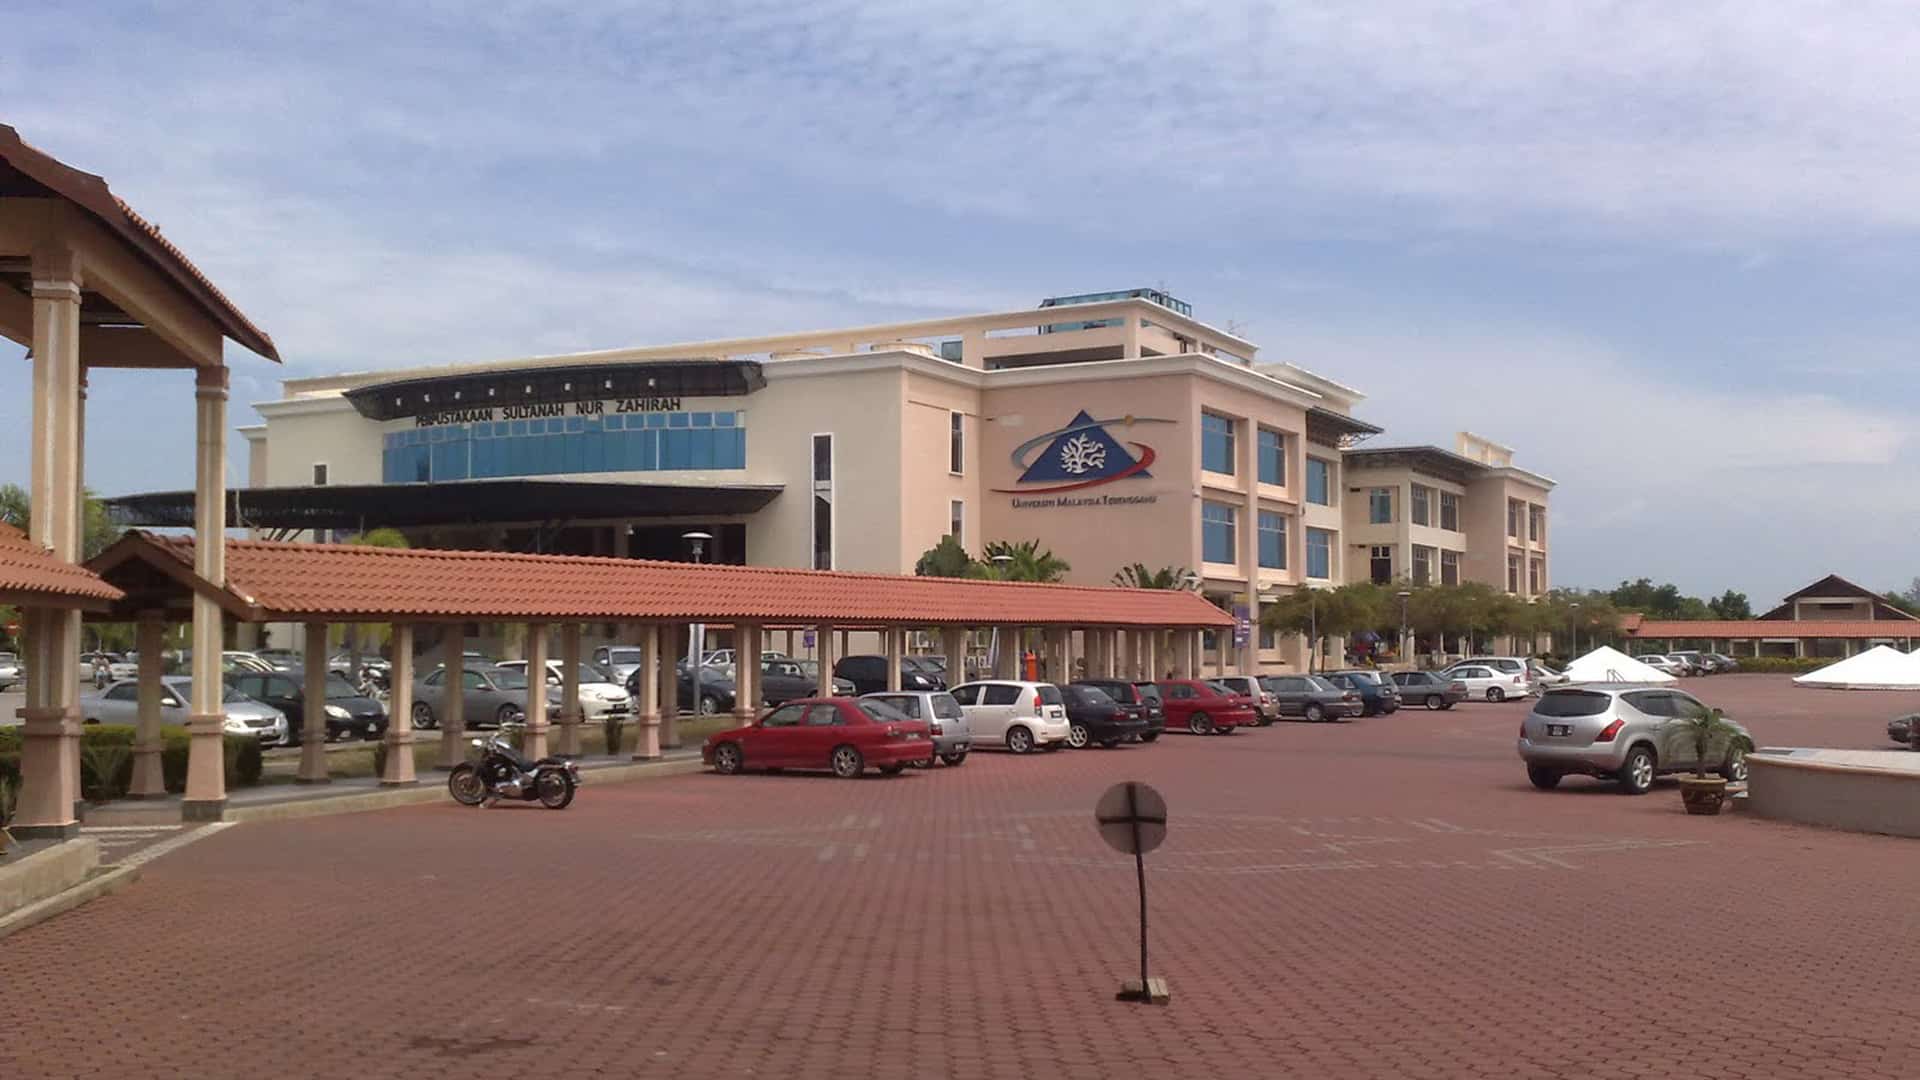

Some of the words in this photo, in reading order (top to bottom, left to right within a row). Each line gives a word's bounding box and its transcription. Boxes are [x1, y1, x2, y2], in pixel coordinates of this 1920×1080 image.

[503, 402, 564, 420] SULTANAH
[575, 400, 604, 416] NUR
[615, 397, 681, 413] ZAHIRAH
